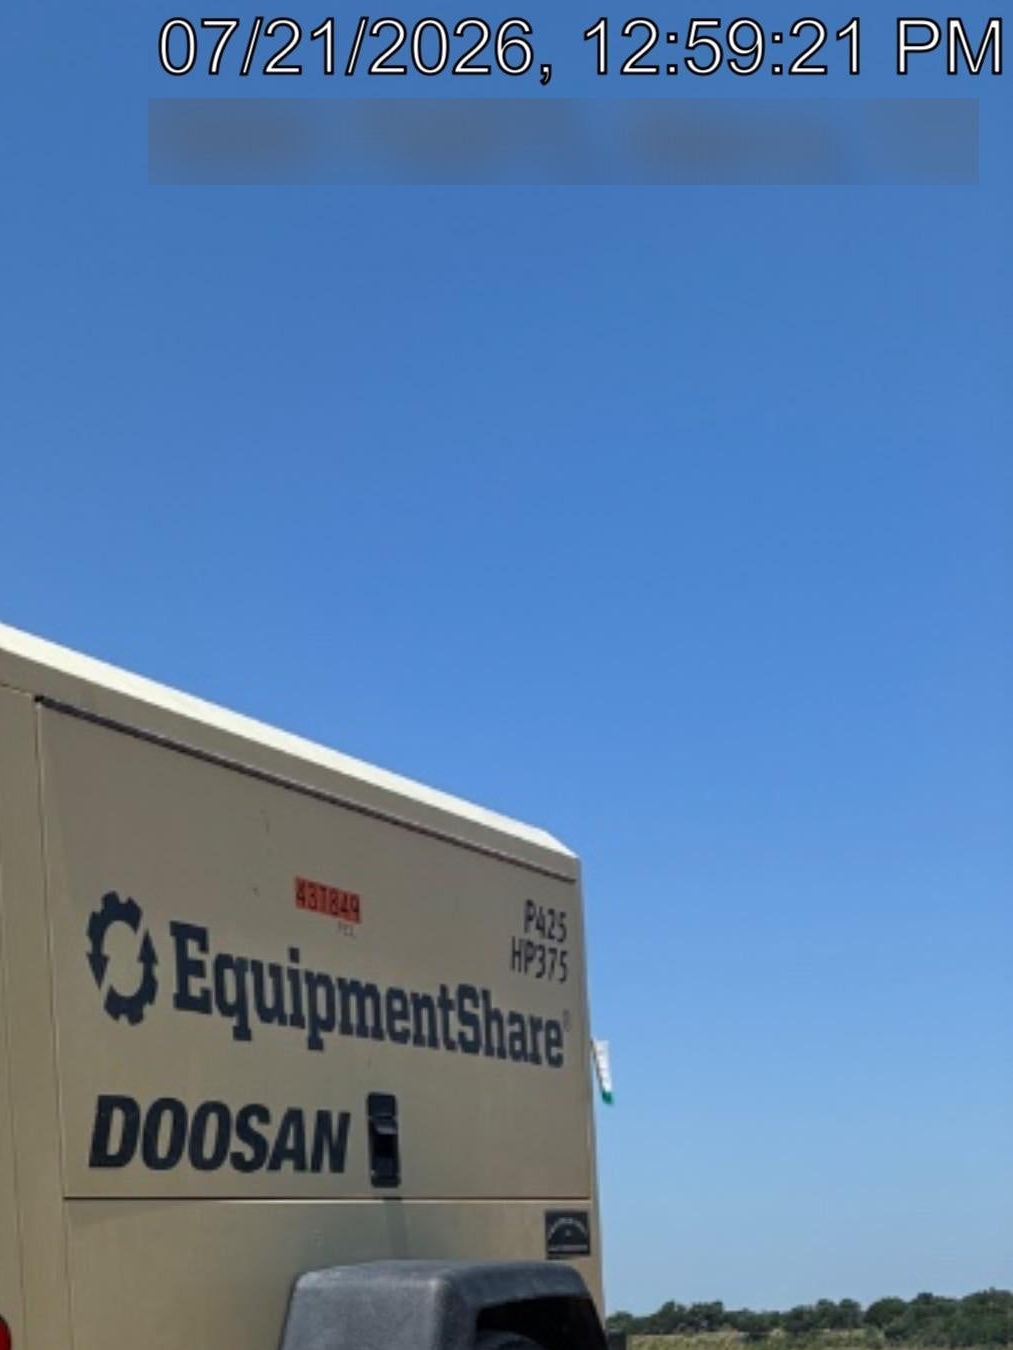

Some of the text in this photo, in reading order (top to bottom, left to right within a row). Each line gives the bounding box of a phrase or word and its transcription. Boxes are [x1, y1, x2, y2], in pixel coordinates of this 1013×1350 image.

[523, 899, 568, 944] P425
[510, 935, 569, 985] HP375
[168, 919, 565, 1069] EquipmentShare
[89, 1094, 352, 1175] DOOSAN
